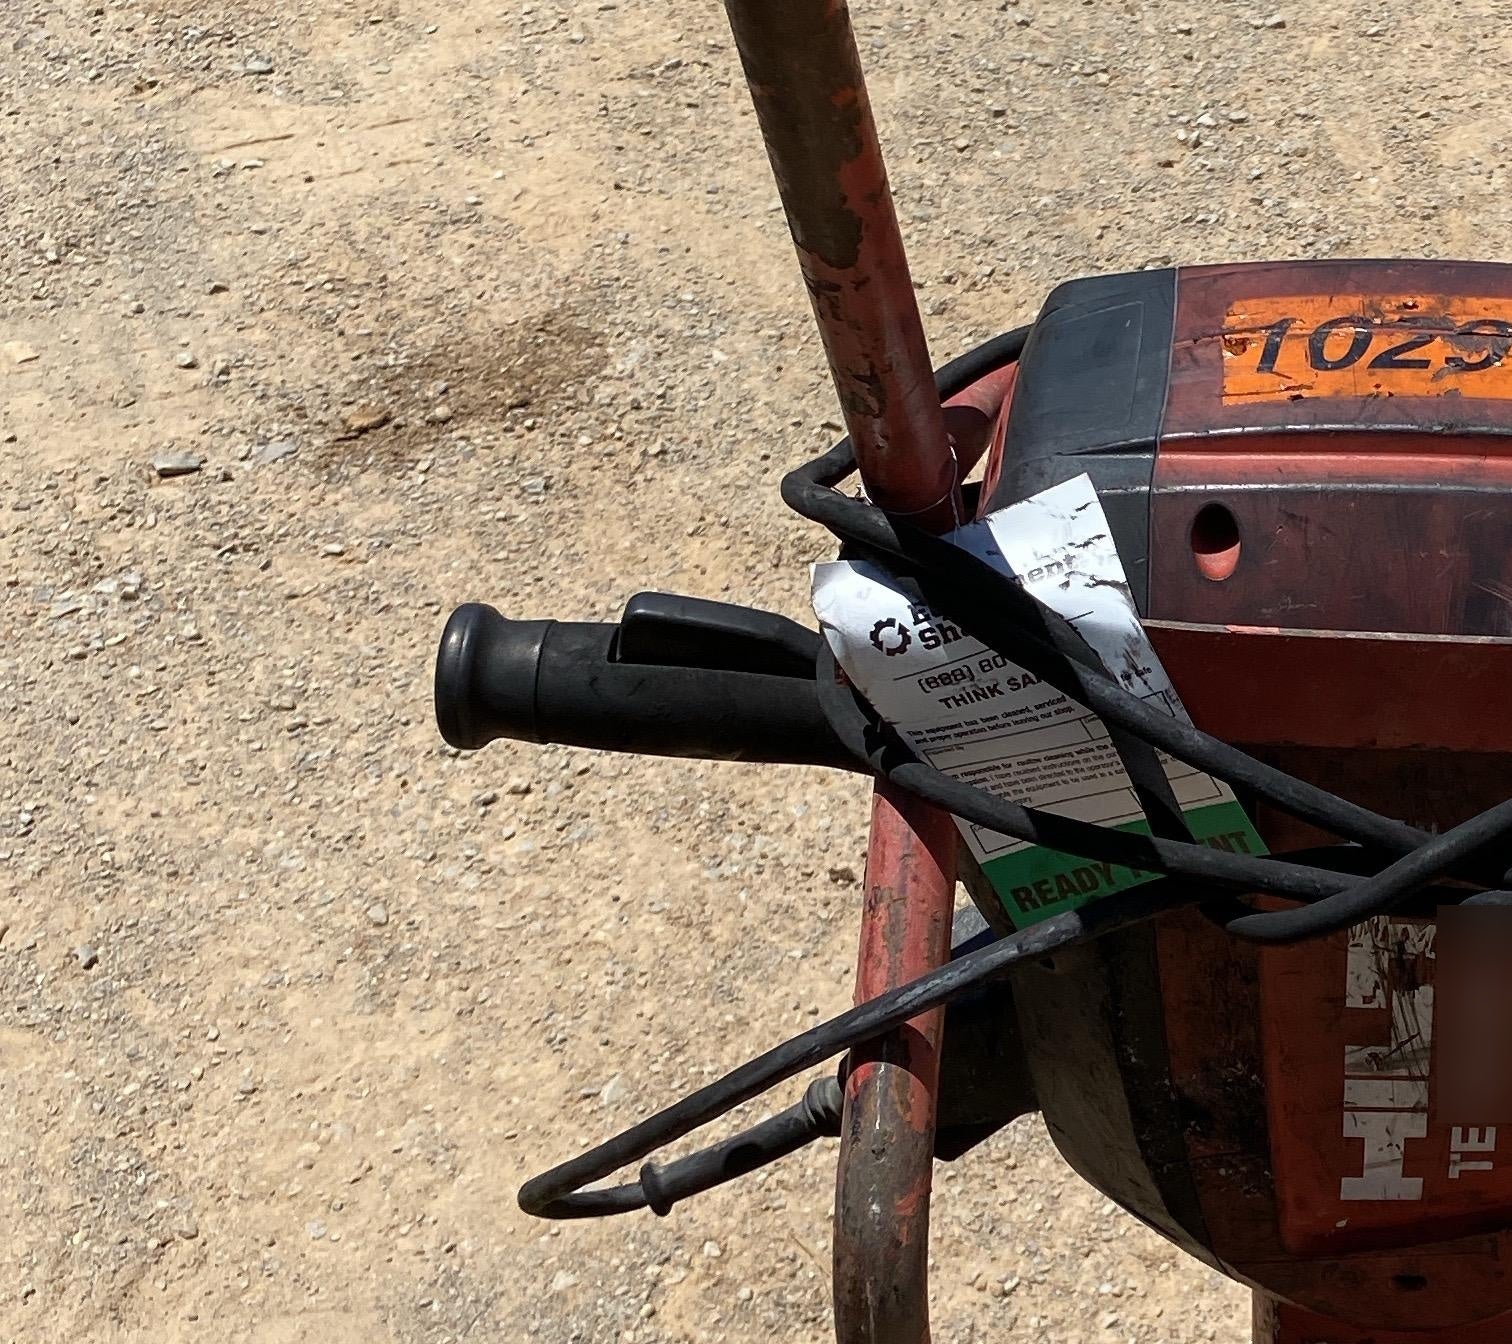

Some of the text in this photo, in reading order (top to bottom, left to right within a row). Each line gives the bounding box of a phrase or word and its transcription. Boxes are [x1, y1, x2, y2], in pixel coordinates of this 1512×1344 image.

[938, 682, 1005, 710] THINK
[1010, 862, 1117, 913] READY
[1447, 1126, 1497, 1179] TE
